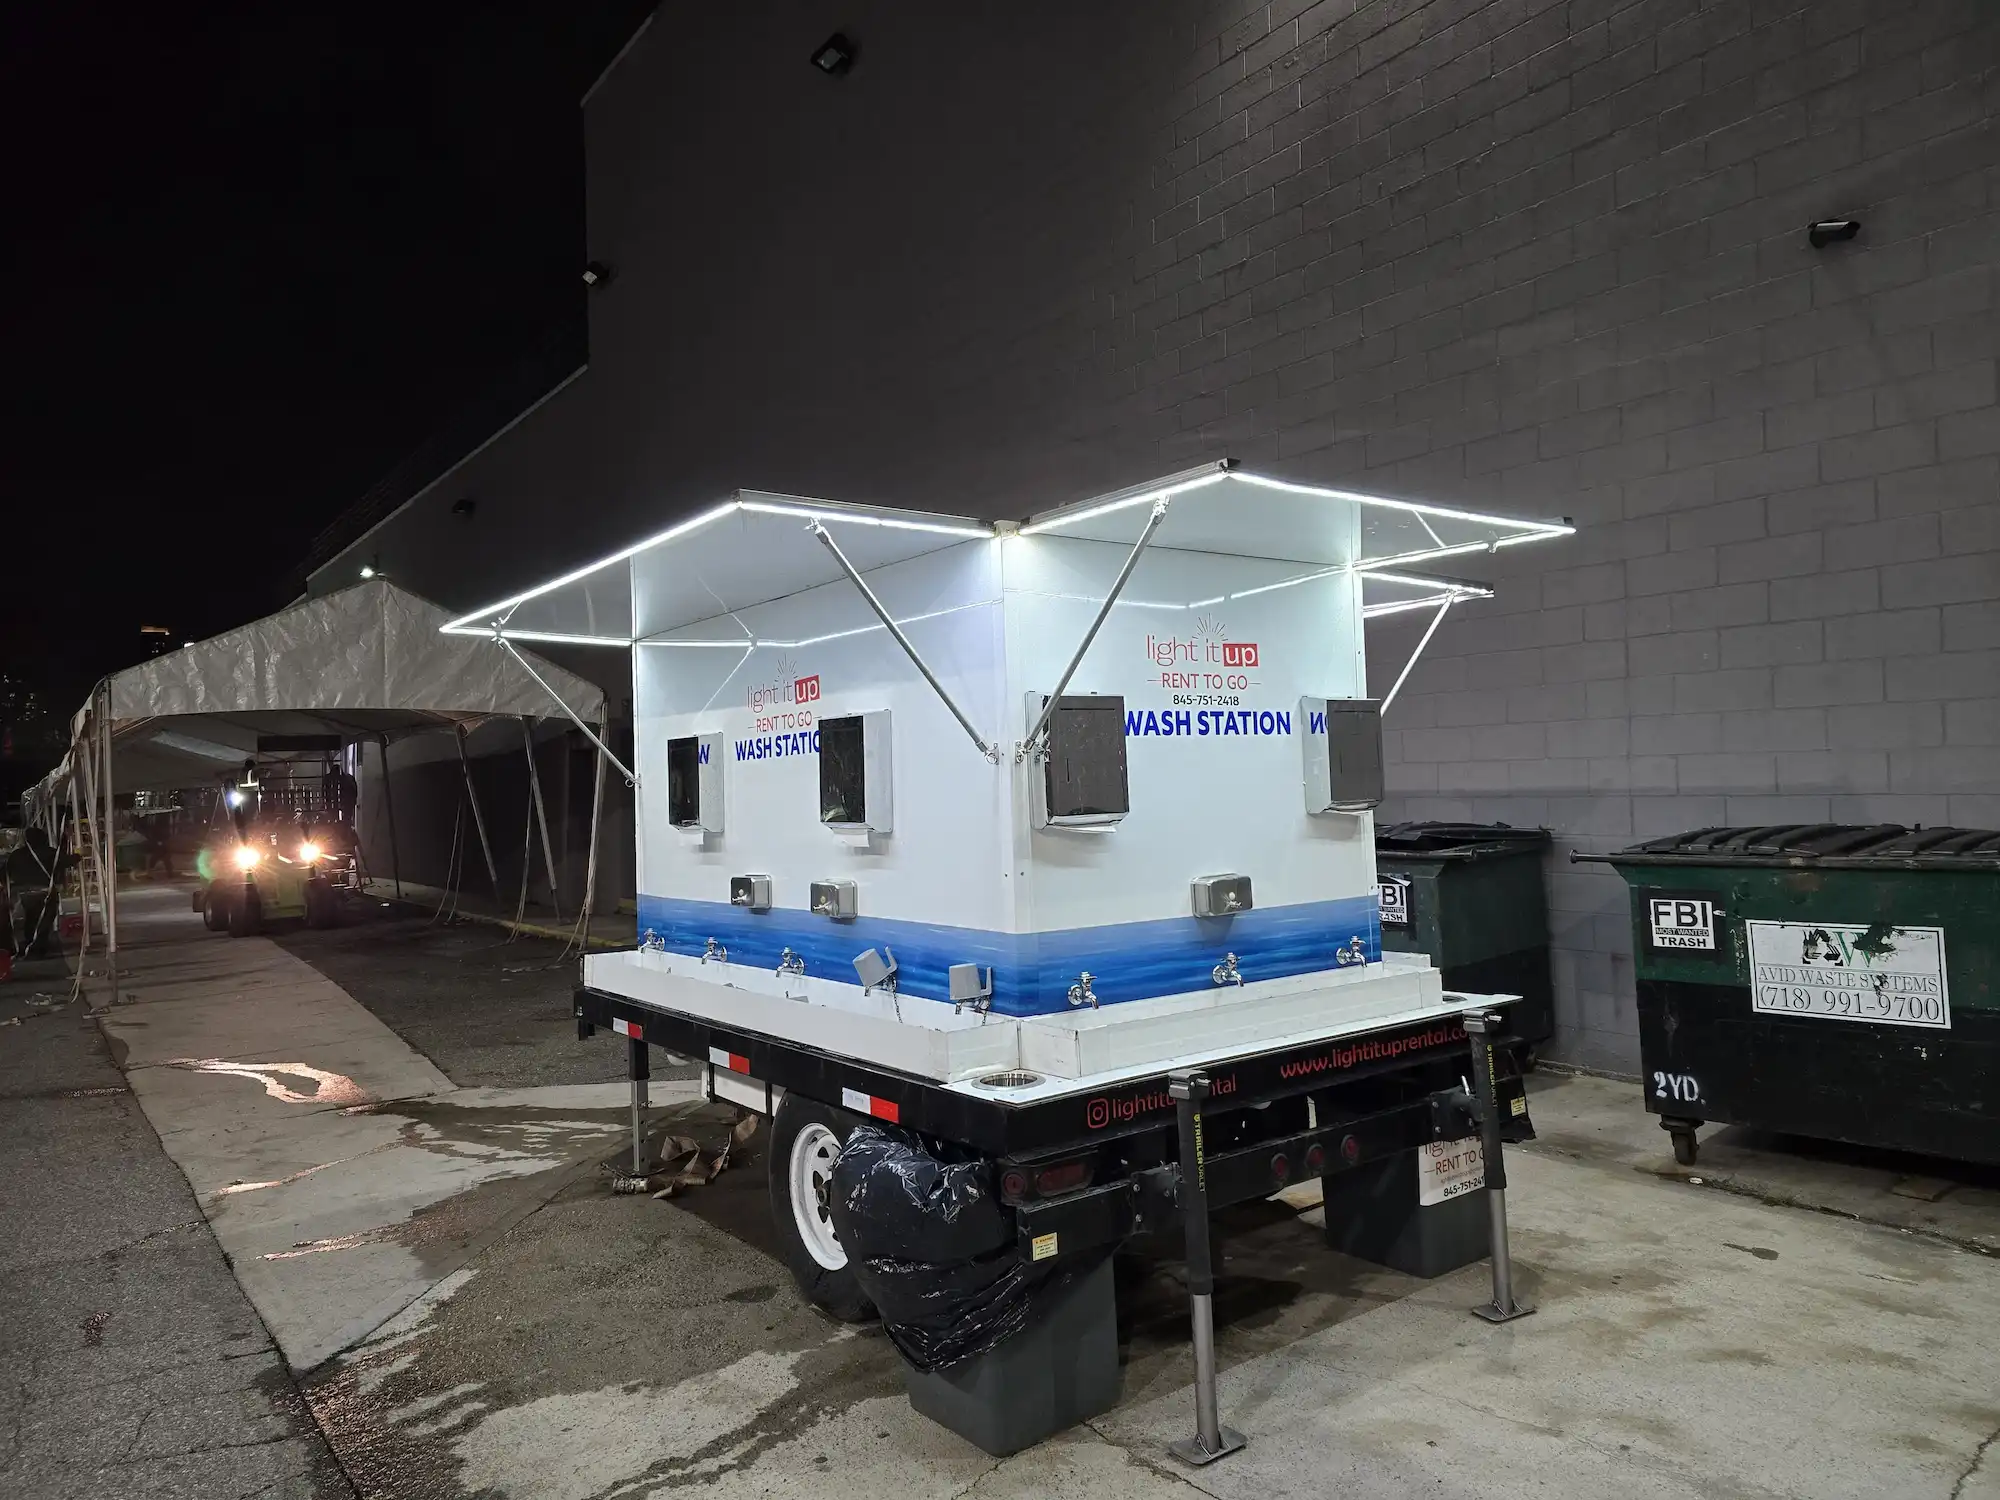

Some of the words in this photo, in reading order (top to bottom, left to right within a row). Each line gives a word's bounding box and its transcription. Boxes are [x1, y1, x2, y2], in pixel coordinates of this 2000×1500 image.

[1147, 635, 1198, 666] light
[1206, 638, 1220, 662] it
[1225, 645, 1256, 667] up
[1162, 672, 1199, 688] RENT
[1203, 674, 1223, 689] TO
[1227, 675, 1248, 690] GO
[747, 684, 778, 713] light
[783, 680, 792, 702] it
[795, 679, 819, 703] up
[1173, 694, 1239, 706] 845-751-2418
[756, 716, 779, 733] RENT
[781, 713, 795, 730] TO
[798, 711, 812, 727] GO
[1126, 710, 1191, 736] WASH
[1197, 710, 1291, 736] STATION
[735, 736, 772, 761] WASH
[775, 730, 821, 757] STATIO
[1381, 885, 1404, 906] BI
[1380, 912, 1403, 921] RASH
[1653, 901, 1709, 928] FBI
[1659, 936, 1706, 947] TRASH
[1677, 929, 1709, 937] WANTED
[1758, 967, 1796, 983] AVID
[1801, 969, 1856, 987] WASTE
[1760, 987, 1811, 1010] (718)
[1824, 990, 1939, 1021] 991-9700
[1280, 1025, 1468, 1079] www.lightituprental.co
[1436, 1155, 1460, 1175] RENT
[1463, 1151, 1476, 1165] TO
